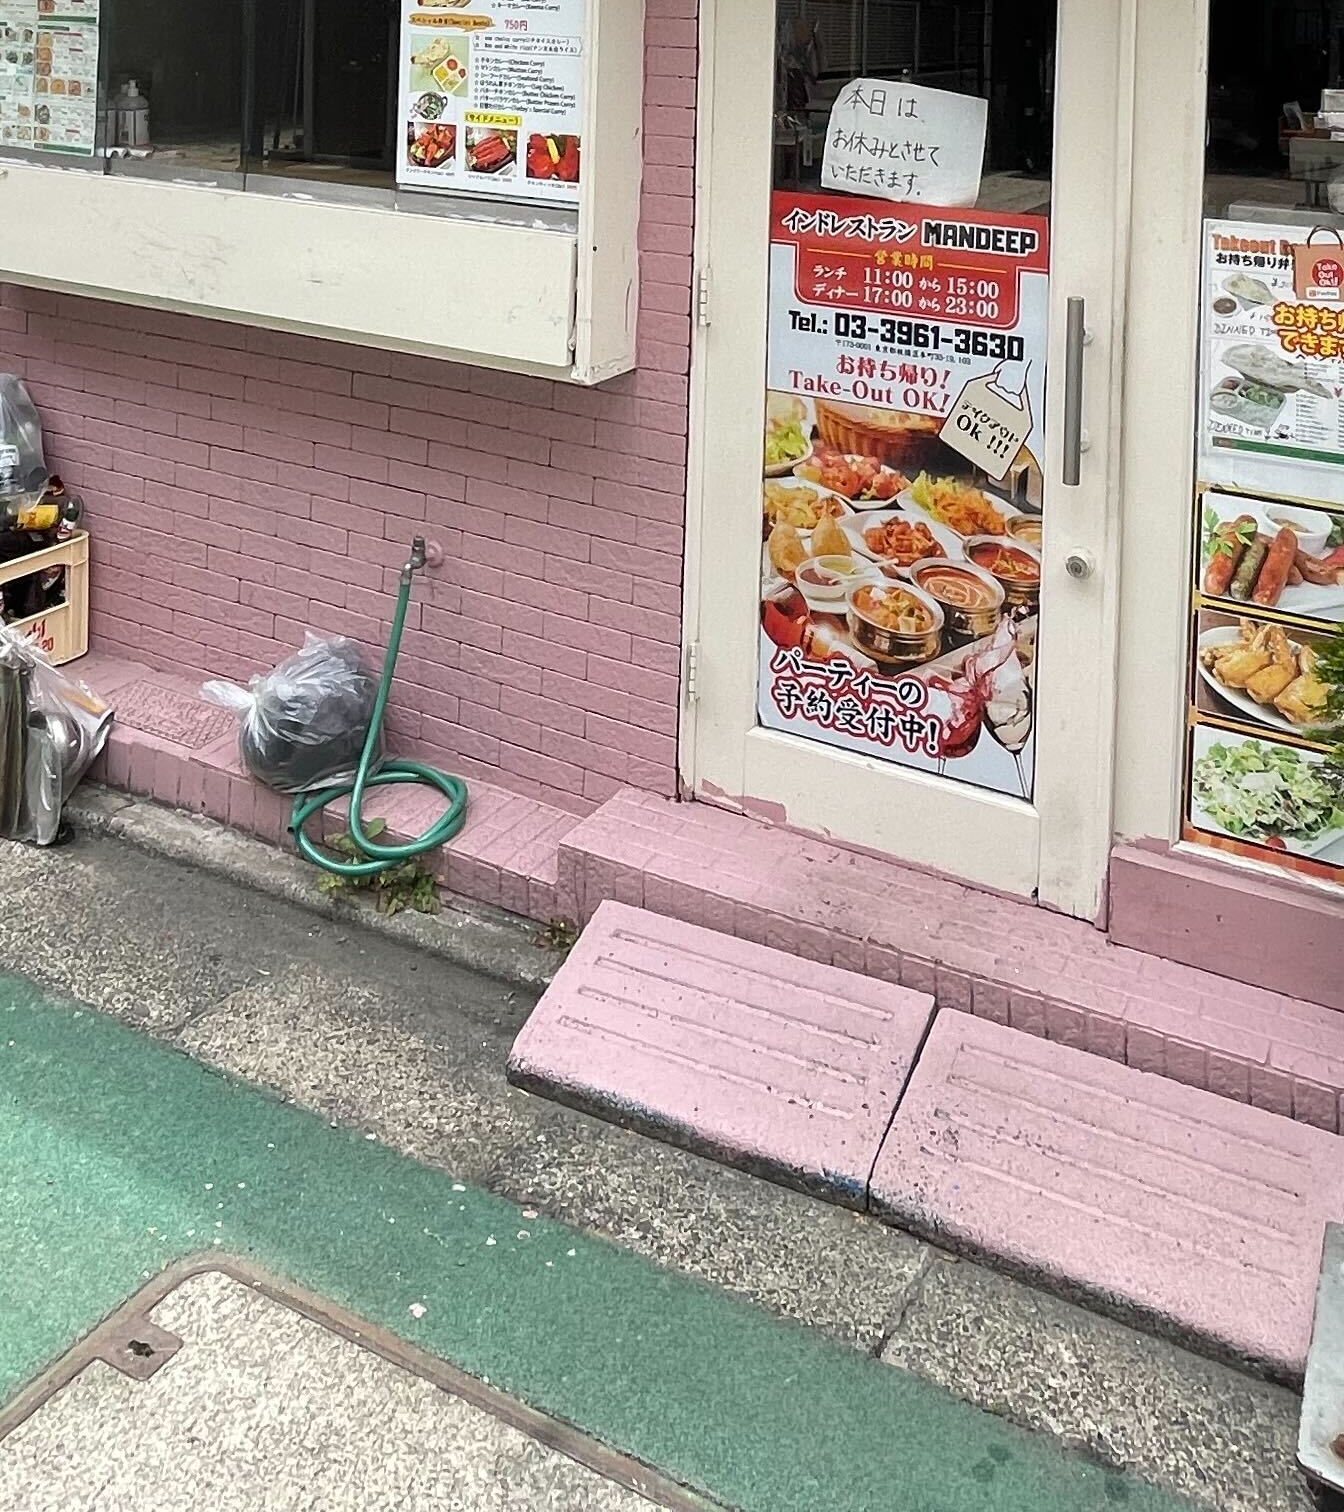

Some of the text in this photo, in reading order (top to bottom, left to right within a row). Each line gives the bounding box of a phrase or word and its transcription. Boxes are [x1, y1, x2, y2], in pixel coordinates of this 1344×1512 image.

[843, 84, 919, 119] 本日は
[831, 128, 940, 168] お休みとさせて
[782, 208, 1038, 256] インドレストラン MANDEEP
[872, 249, 936, 272] 営業時間
[1215, 252, 1295, 271] お持ち帰り弁
[812, 263, 1000, 300] ランチ 11:00 から 15:00
[812, 284, 1000, 320] ディナー 17:00 から 23:00
[833, 311, 1025, 362] 03-3961-3630
[836, 353, 952, 390] お持ち帰り!
[788, 368, 952, 414] Take-Out OK!
[772, 647, 924, 706] パーティーの
[771, 683, 942, 755] 予約受付中!
